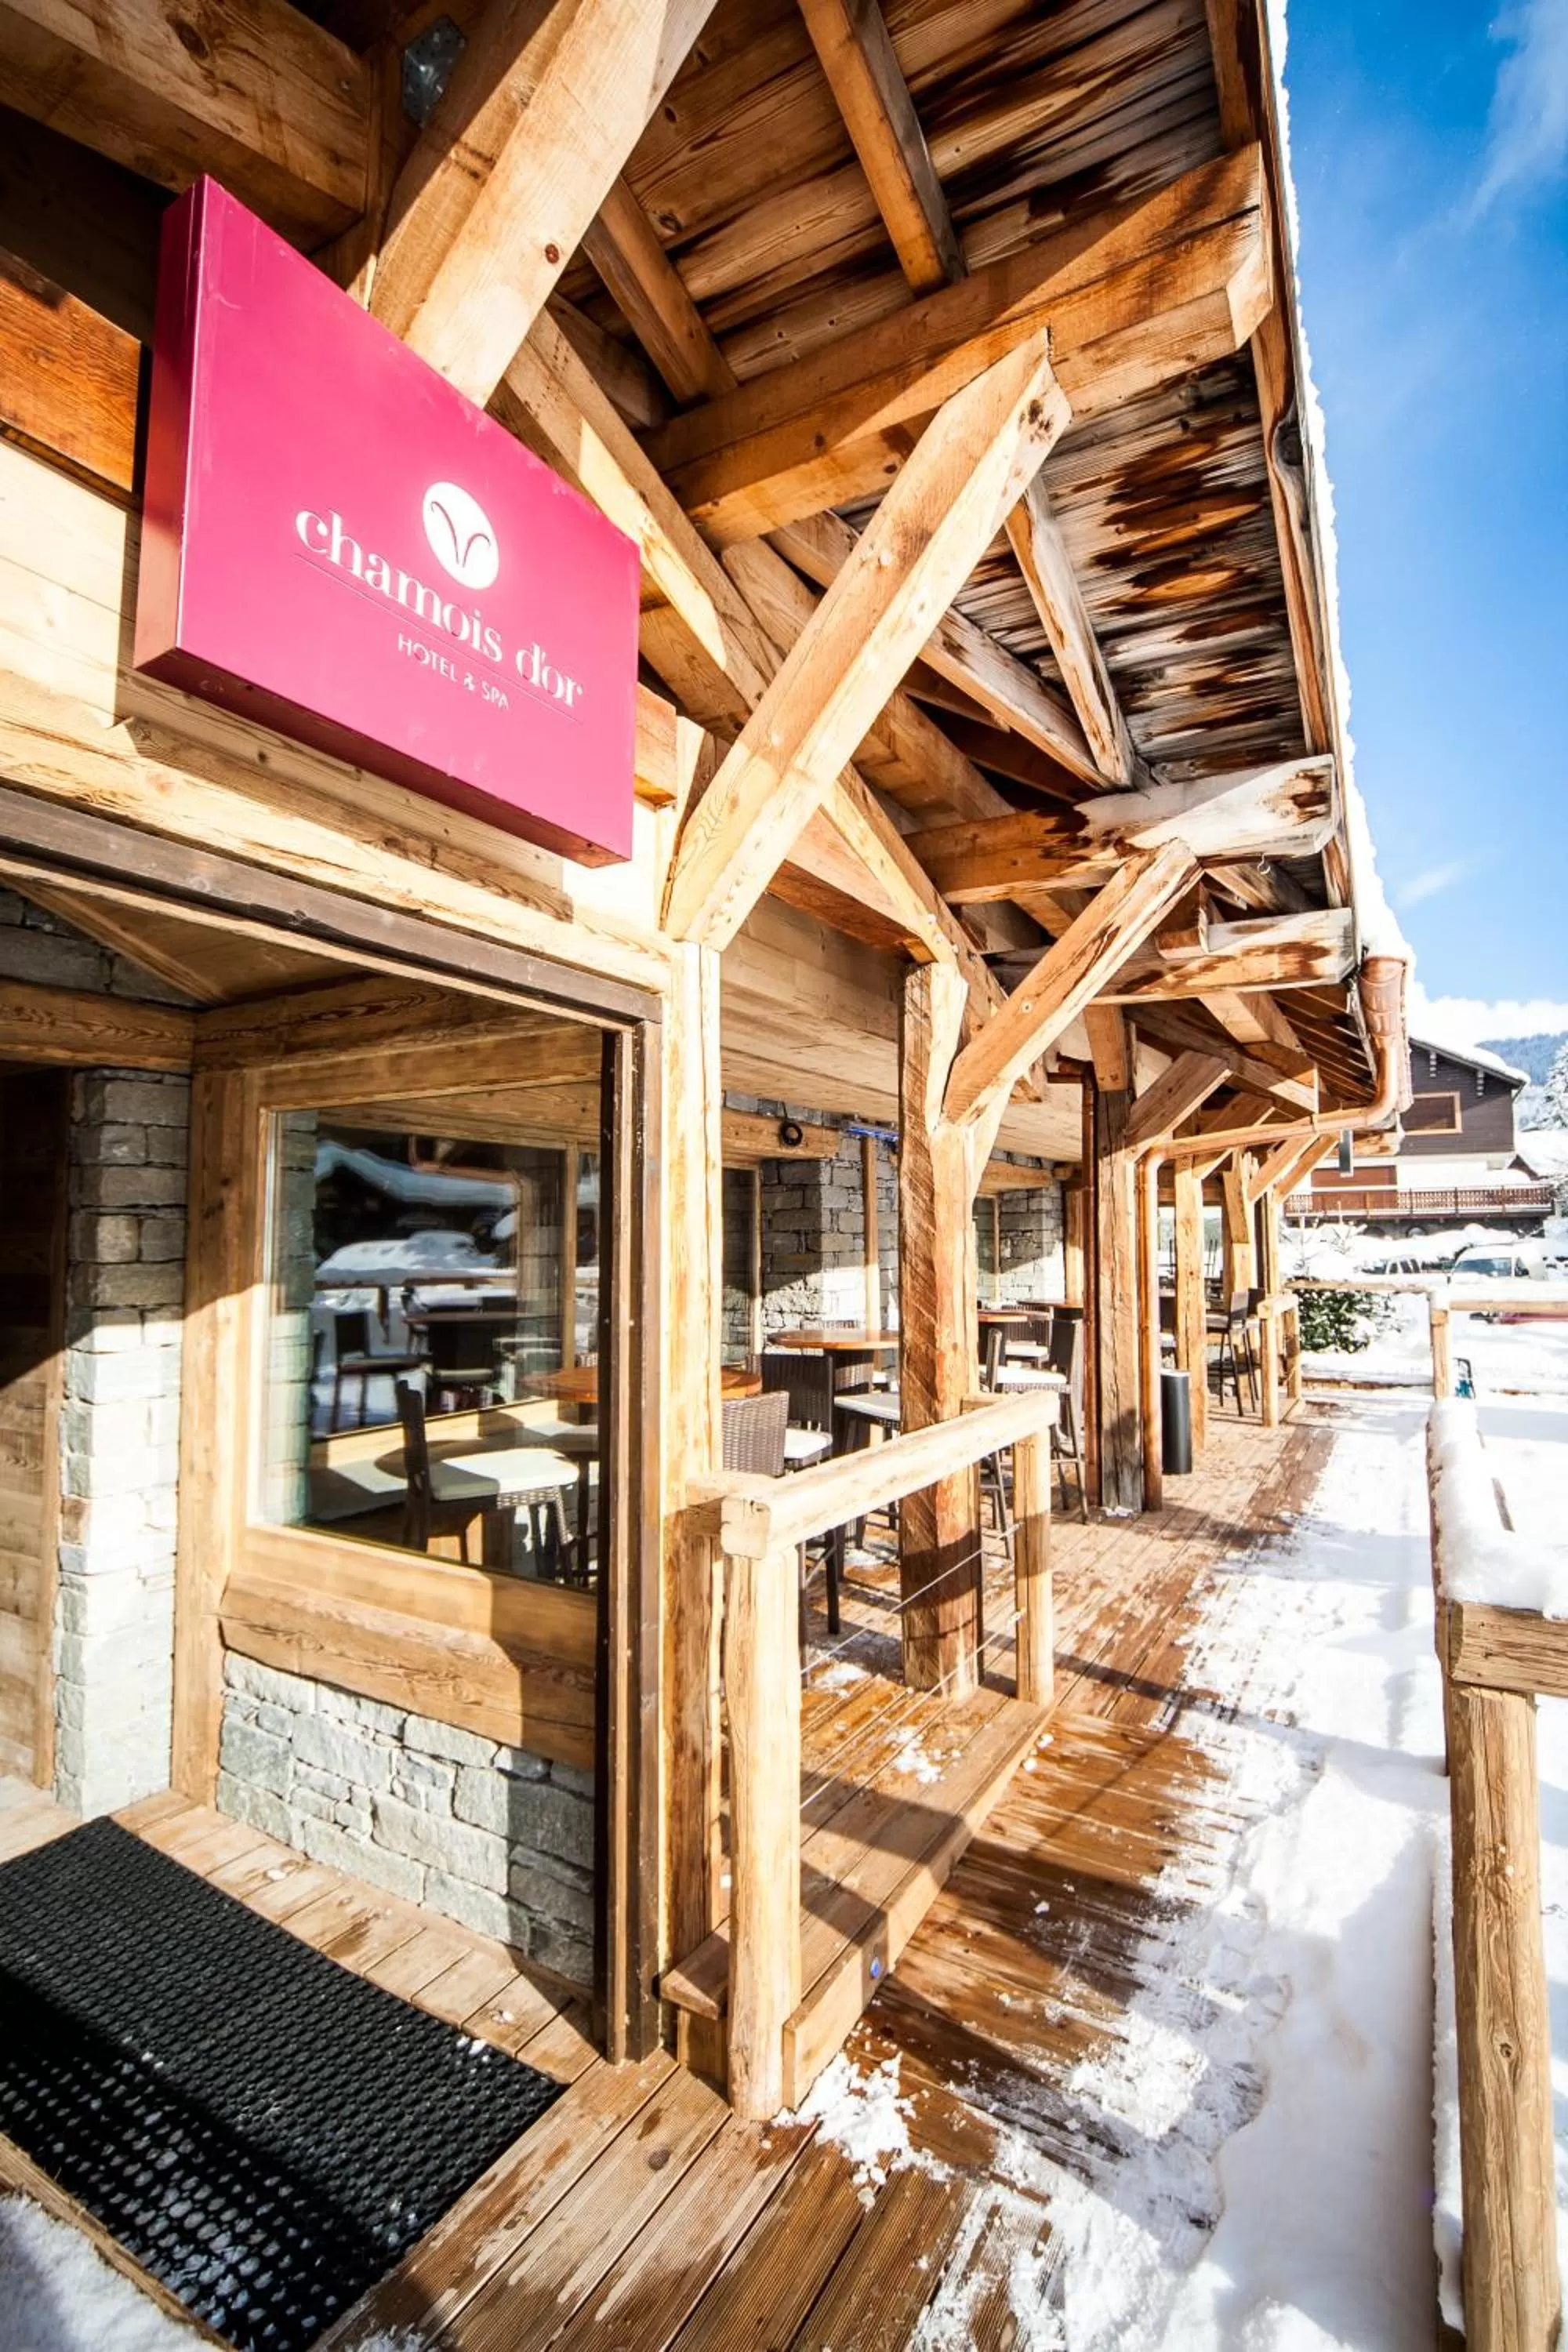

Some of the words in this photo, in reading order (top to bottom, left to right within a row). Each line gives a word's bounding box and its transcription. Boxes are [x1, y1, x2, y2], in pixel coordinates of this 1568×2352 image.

[296, 509, 503, 662] chamois
[515, 642, 583, 707] d'or
[397, 633, 457, 682] HOTEL
[463, 672, 477, 691] &
[482, 681, 510, 710] SPA
